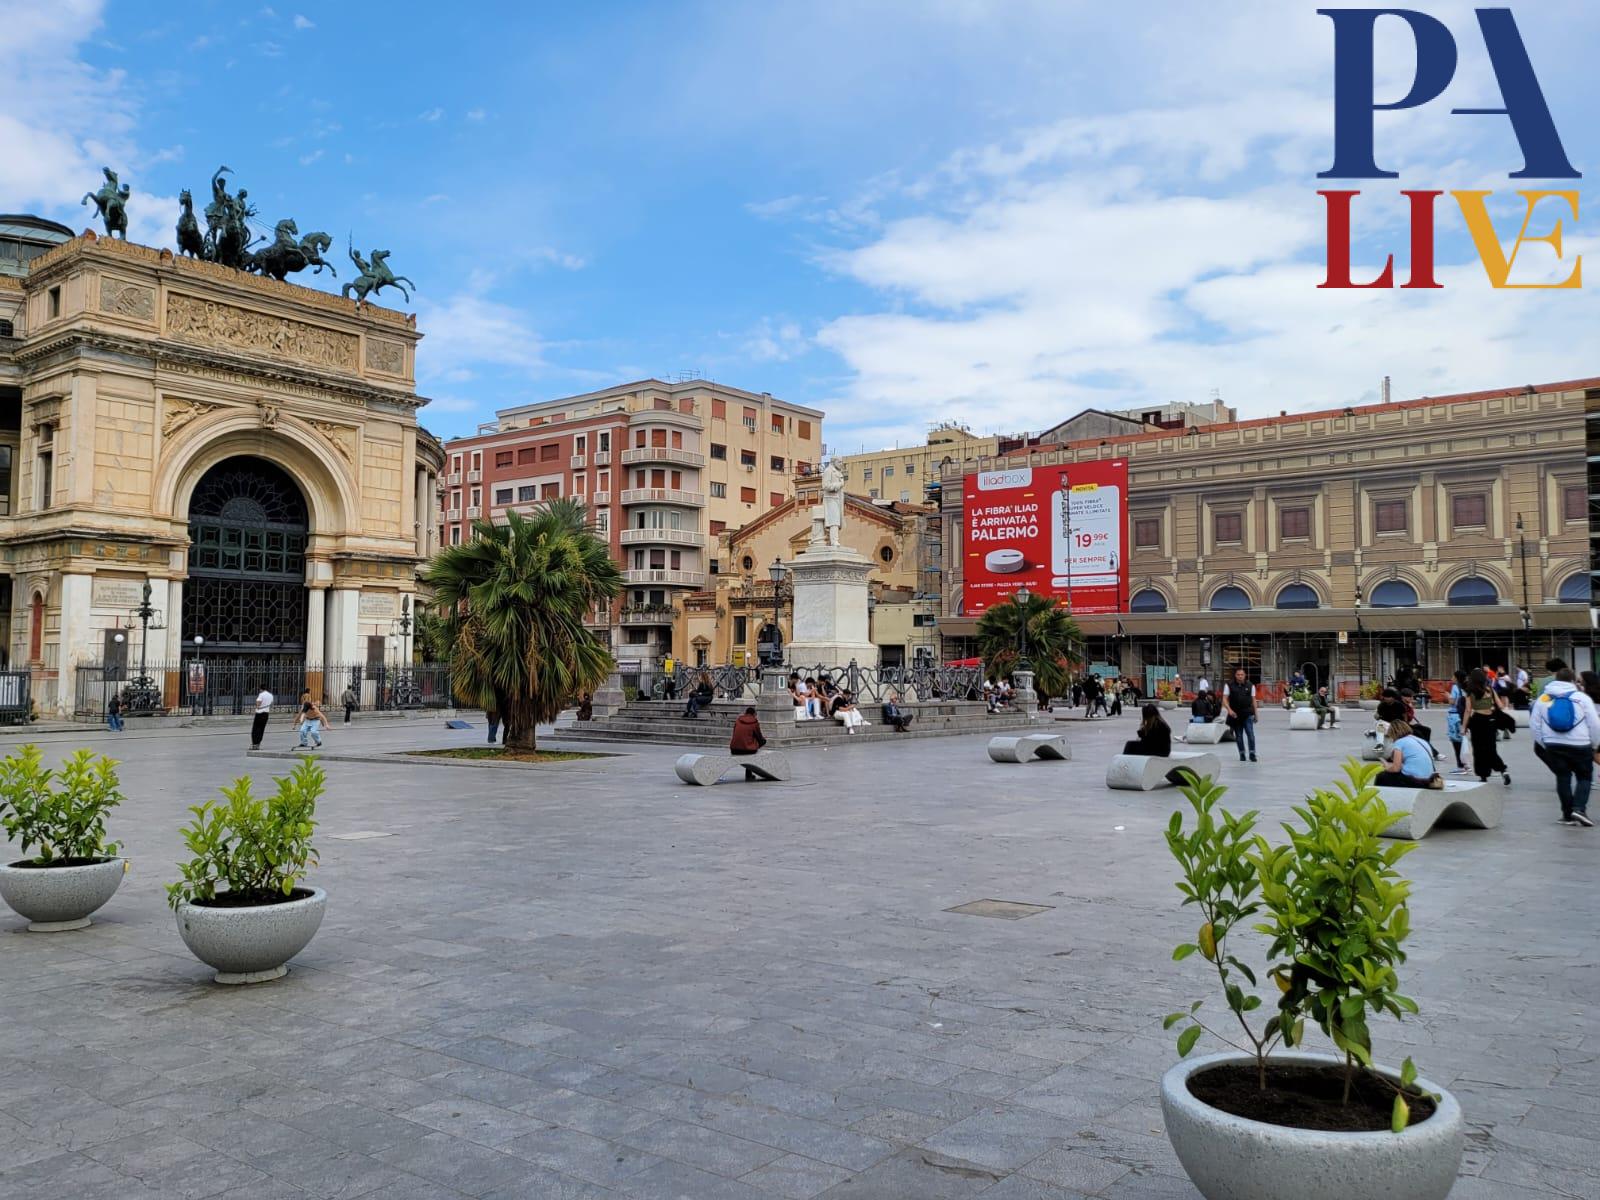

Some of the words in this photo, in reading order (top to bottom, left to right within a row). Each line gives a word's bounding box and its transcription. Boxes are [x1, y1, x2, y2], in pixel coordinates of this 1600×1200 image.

[202, 368, 266, 389] POLITEAMA
[983, 474, 1026, 487] iliadbox
[971, 508, 983, 517] LA
[1014, 504, 1038, 513] ILIAD
[971, 517, 978, 528] È
[980, 515, 1027, 527] ARRIVATA
[1029, 514, 1037, 523] A
[971, 525, 1039, 542] PALERMO
[1079, 556, 1107, 564] SEMPRE
